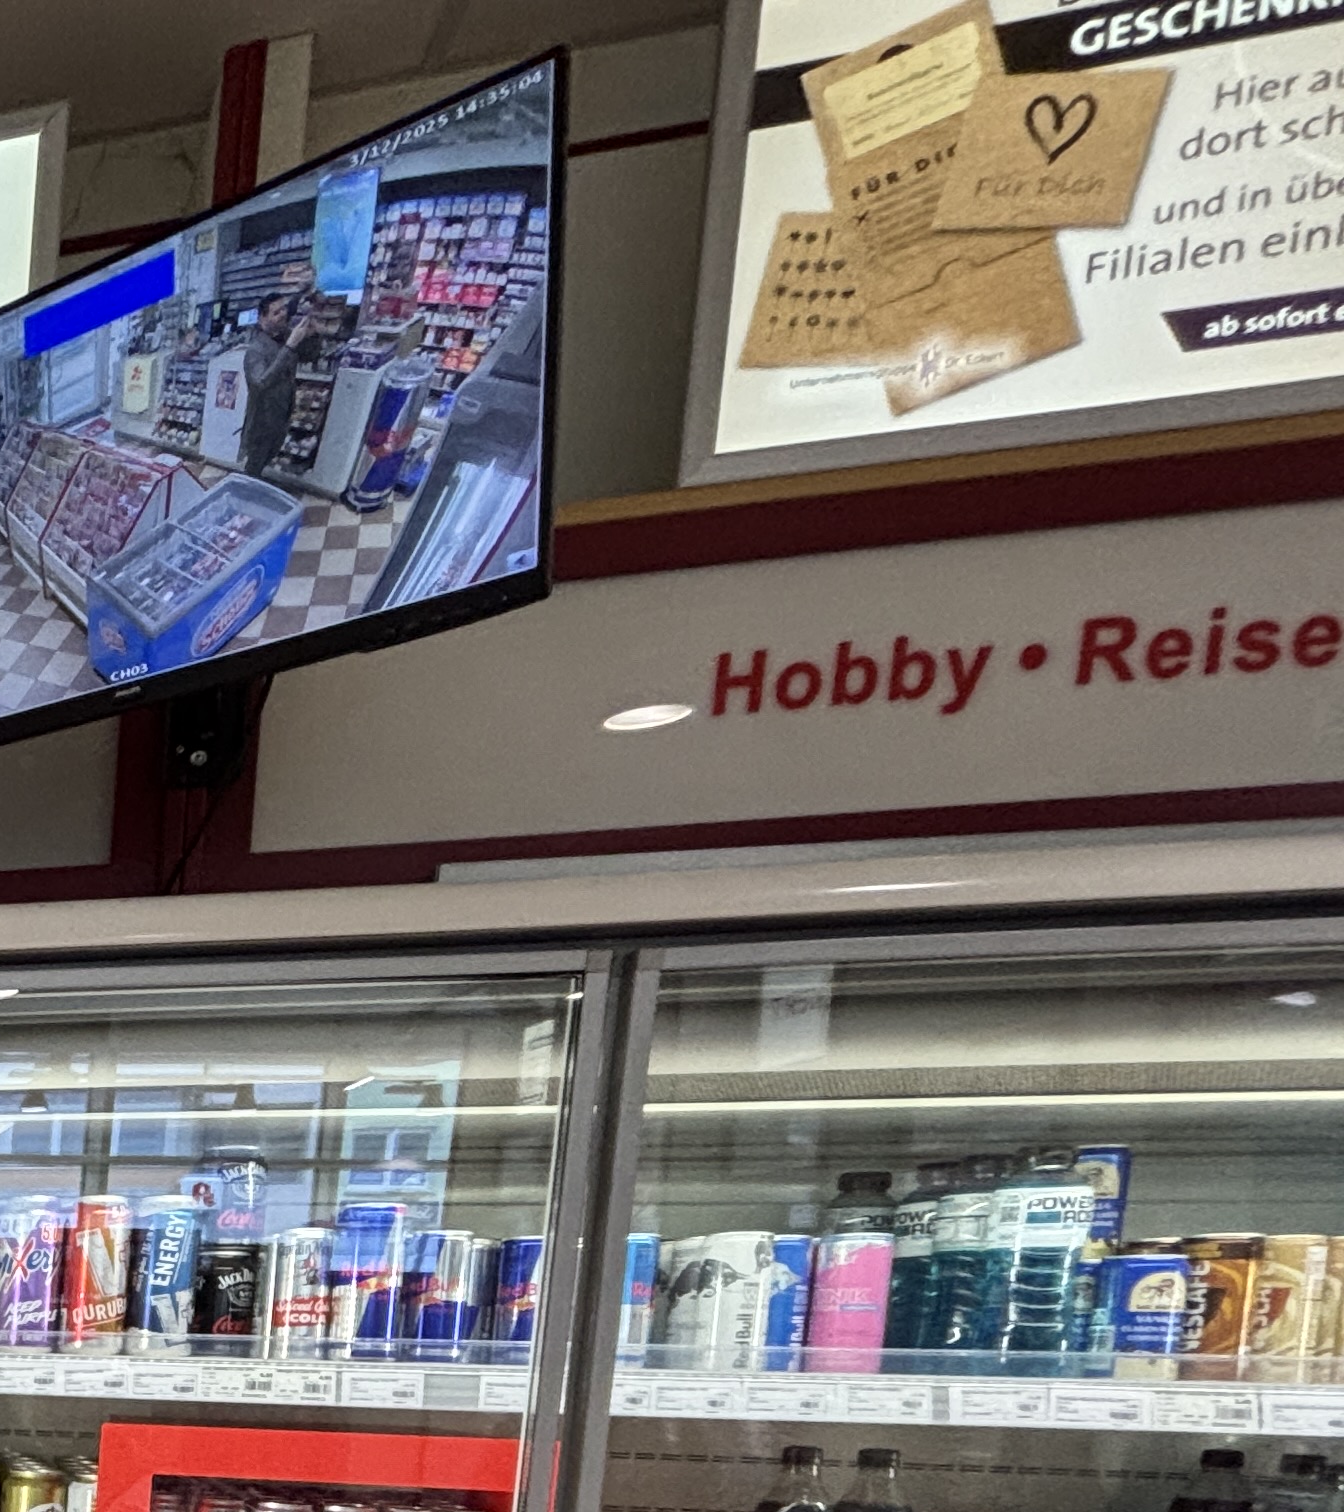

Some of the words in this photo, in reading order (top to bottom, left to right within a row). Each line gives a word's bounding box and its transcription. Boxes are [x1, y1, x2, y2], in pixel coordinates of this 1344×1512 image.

[455, 69, 544, 120] 14:35:04
[1214, 72, 1299, 111] Hier
[1179, 119, 1269, 161] dort
[1154, 185, 1228, 225] und
[1238, 183, 1272, 211] in
[1085, 236, 1245, 284] Filialen
[1202, 314, 1239, 339] ab
[1245, 305, 1328, 334] sofort
[110, 663, 149, 682] CH03
[711, 637, 994, 716] Hobby
[1075, 606, 1344, 686] Reise
[150, 1213, 188, 1287] ENERGY
